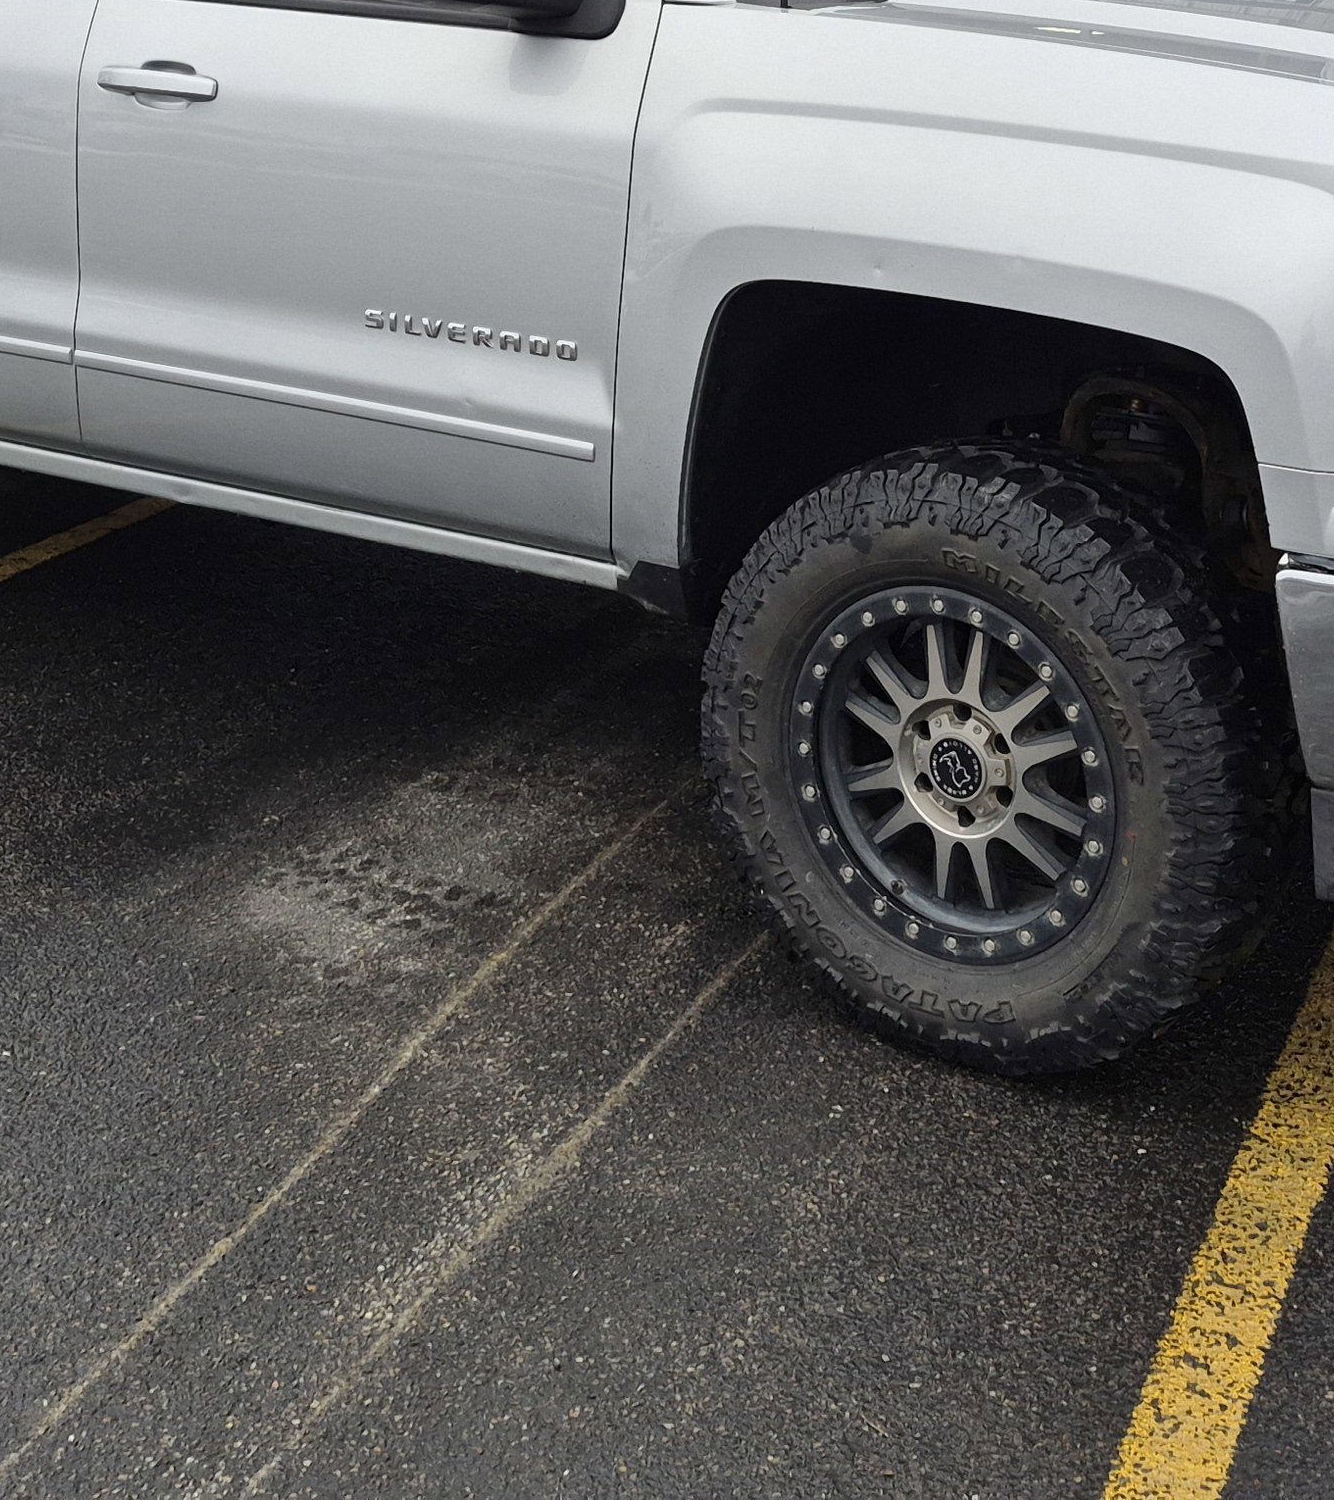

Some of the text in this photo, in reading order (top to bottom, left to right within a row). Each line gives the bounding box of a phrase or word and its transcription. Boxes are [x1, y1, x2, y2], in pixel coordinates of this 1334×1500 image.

[365, 308, 578, 361] SILVERADO
[941, 547, 1145, 786] MILESTAR
[760, 829, 1017, 1025] PATAGONIA
